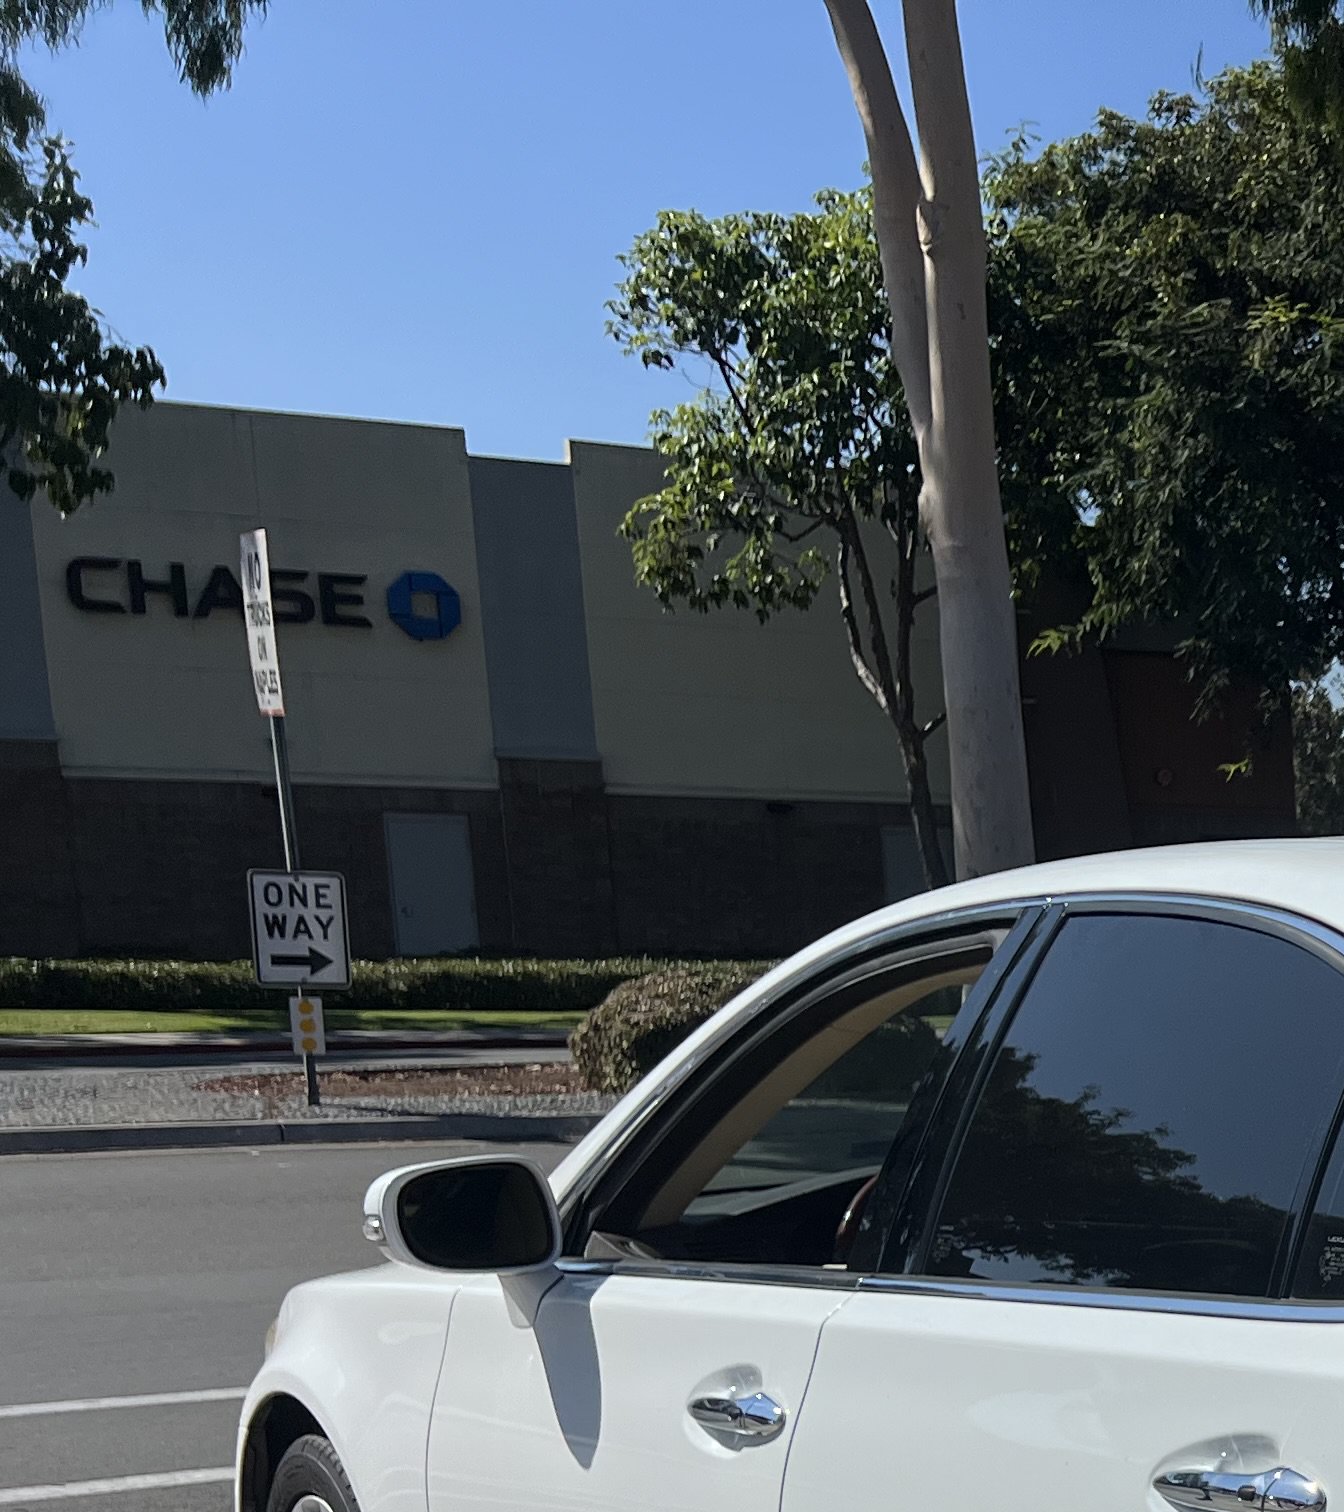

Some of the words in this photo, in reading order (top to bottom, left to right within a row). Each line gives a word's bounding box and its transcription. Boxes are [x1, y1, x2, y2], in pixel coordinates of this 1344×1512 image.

[66, 556, 373, 628] CHASE
[263, 881, 333, 910] ONE
[263, 912, 335, 942] WAY
